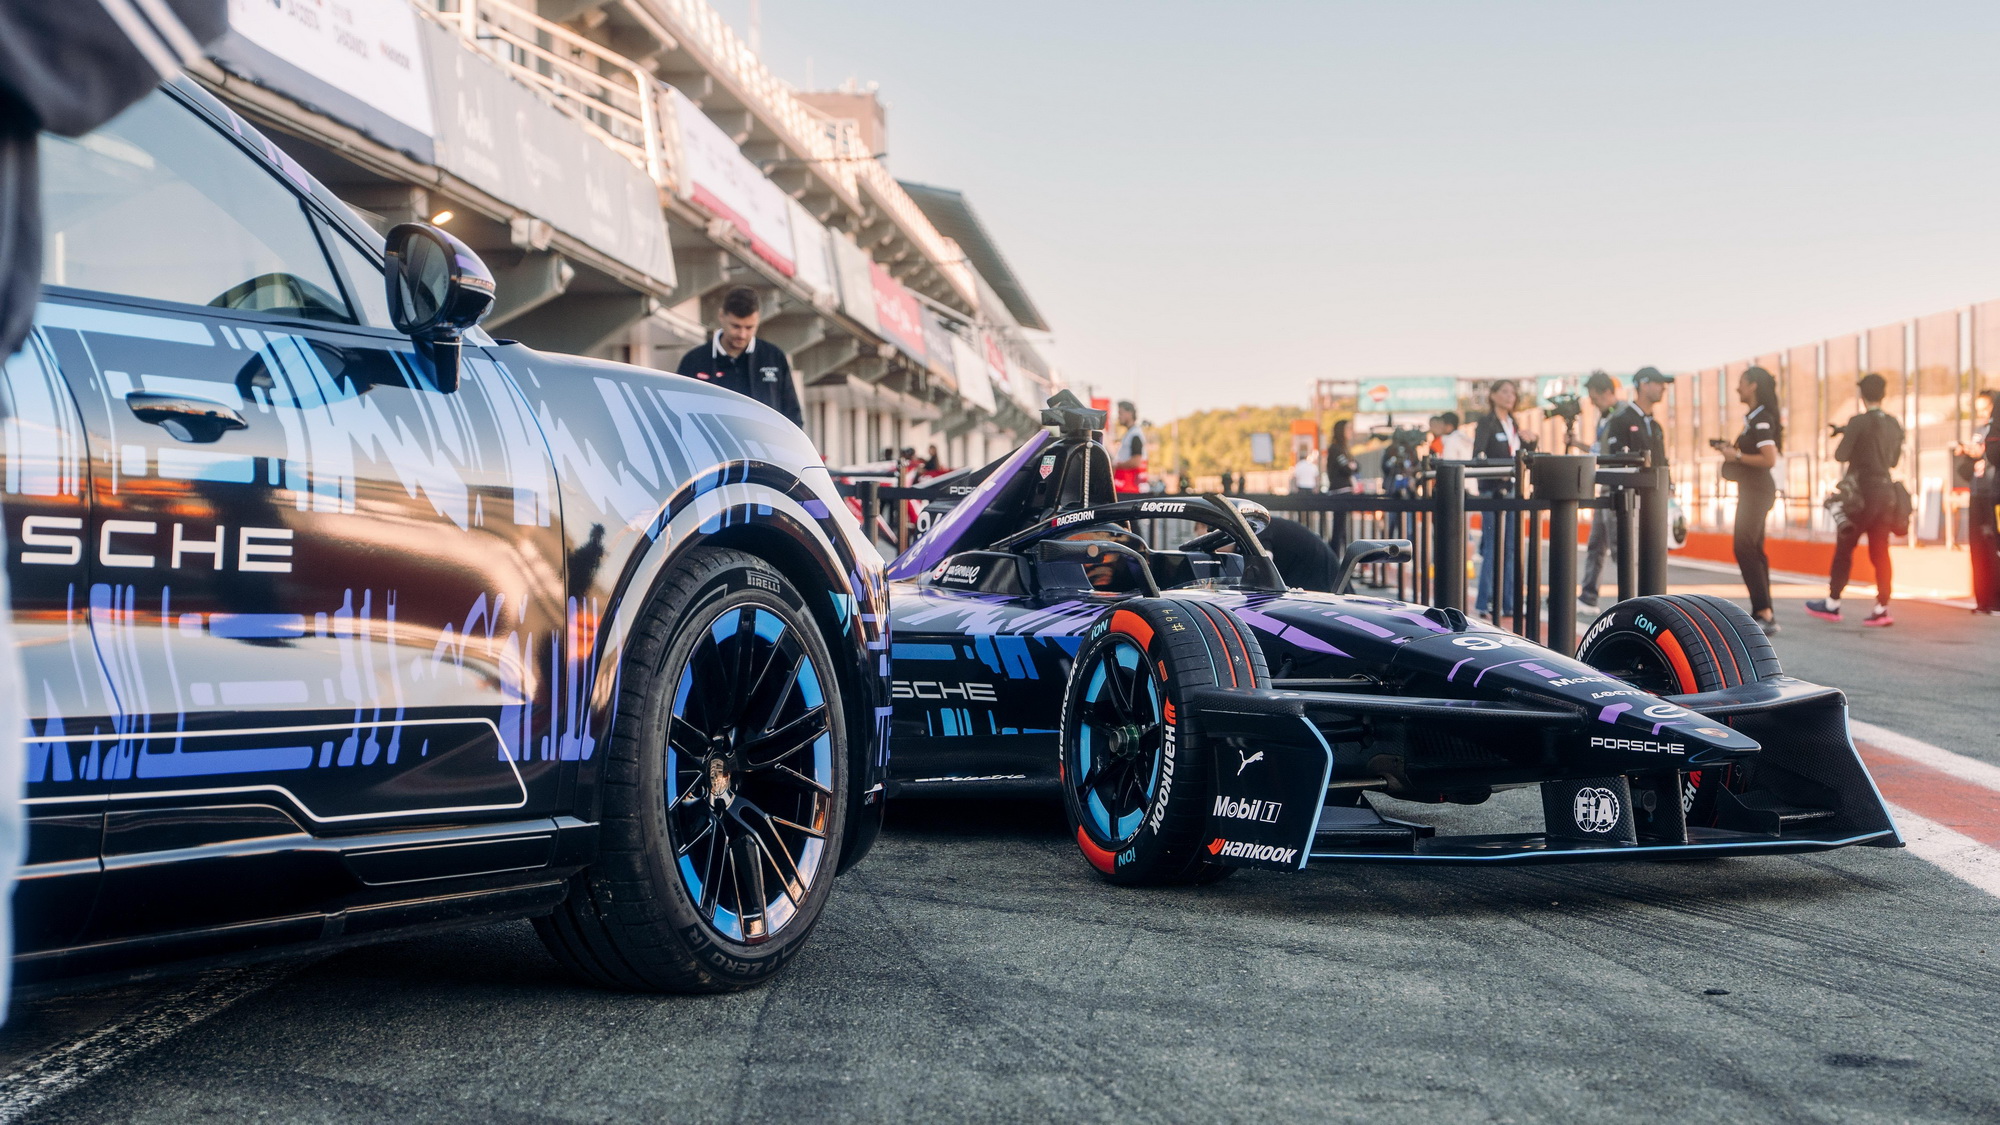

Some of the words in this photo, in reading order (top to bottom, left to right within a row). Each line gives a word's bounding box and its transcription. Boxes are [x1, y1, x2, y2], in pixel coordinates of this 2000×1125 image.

[1043, 456, 1055, 465] TAG
[1141, 502, 1187, 513] LOCTITE
[1057, 510, 1095, 527] RACEBORN
[21, 515, 294, 573] SCHE
[746, 570, 780, 594] PIRELLI
[892, 680, 998, 701] SCHE
[1591, 737, 1685, 754] PORSCHE
[1213, 795, 1262, 821] Mobil
[710, 952, 764, 975] ZERO
